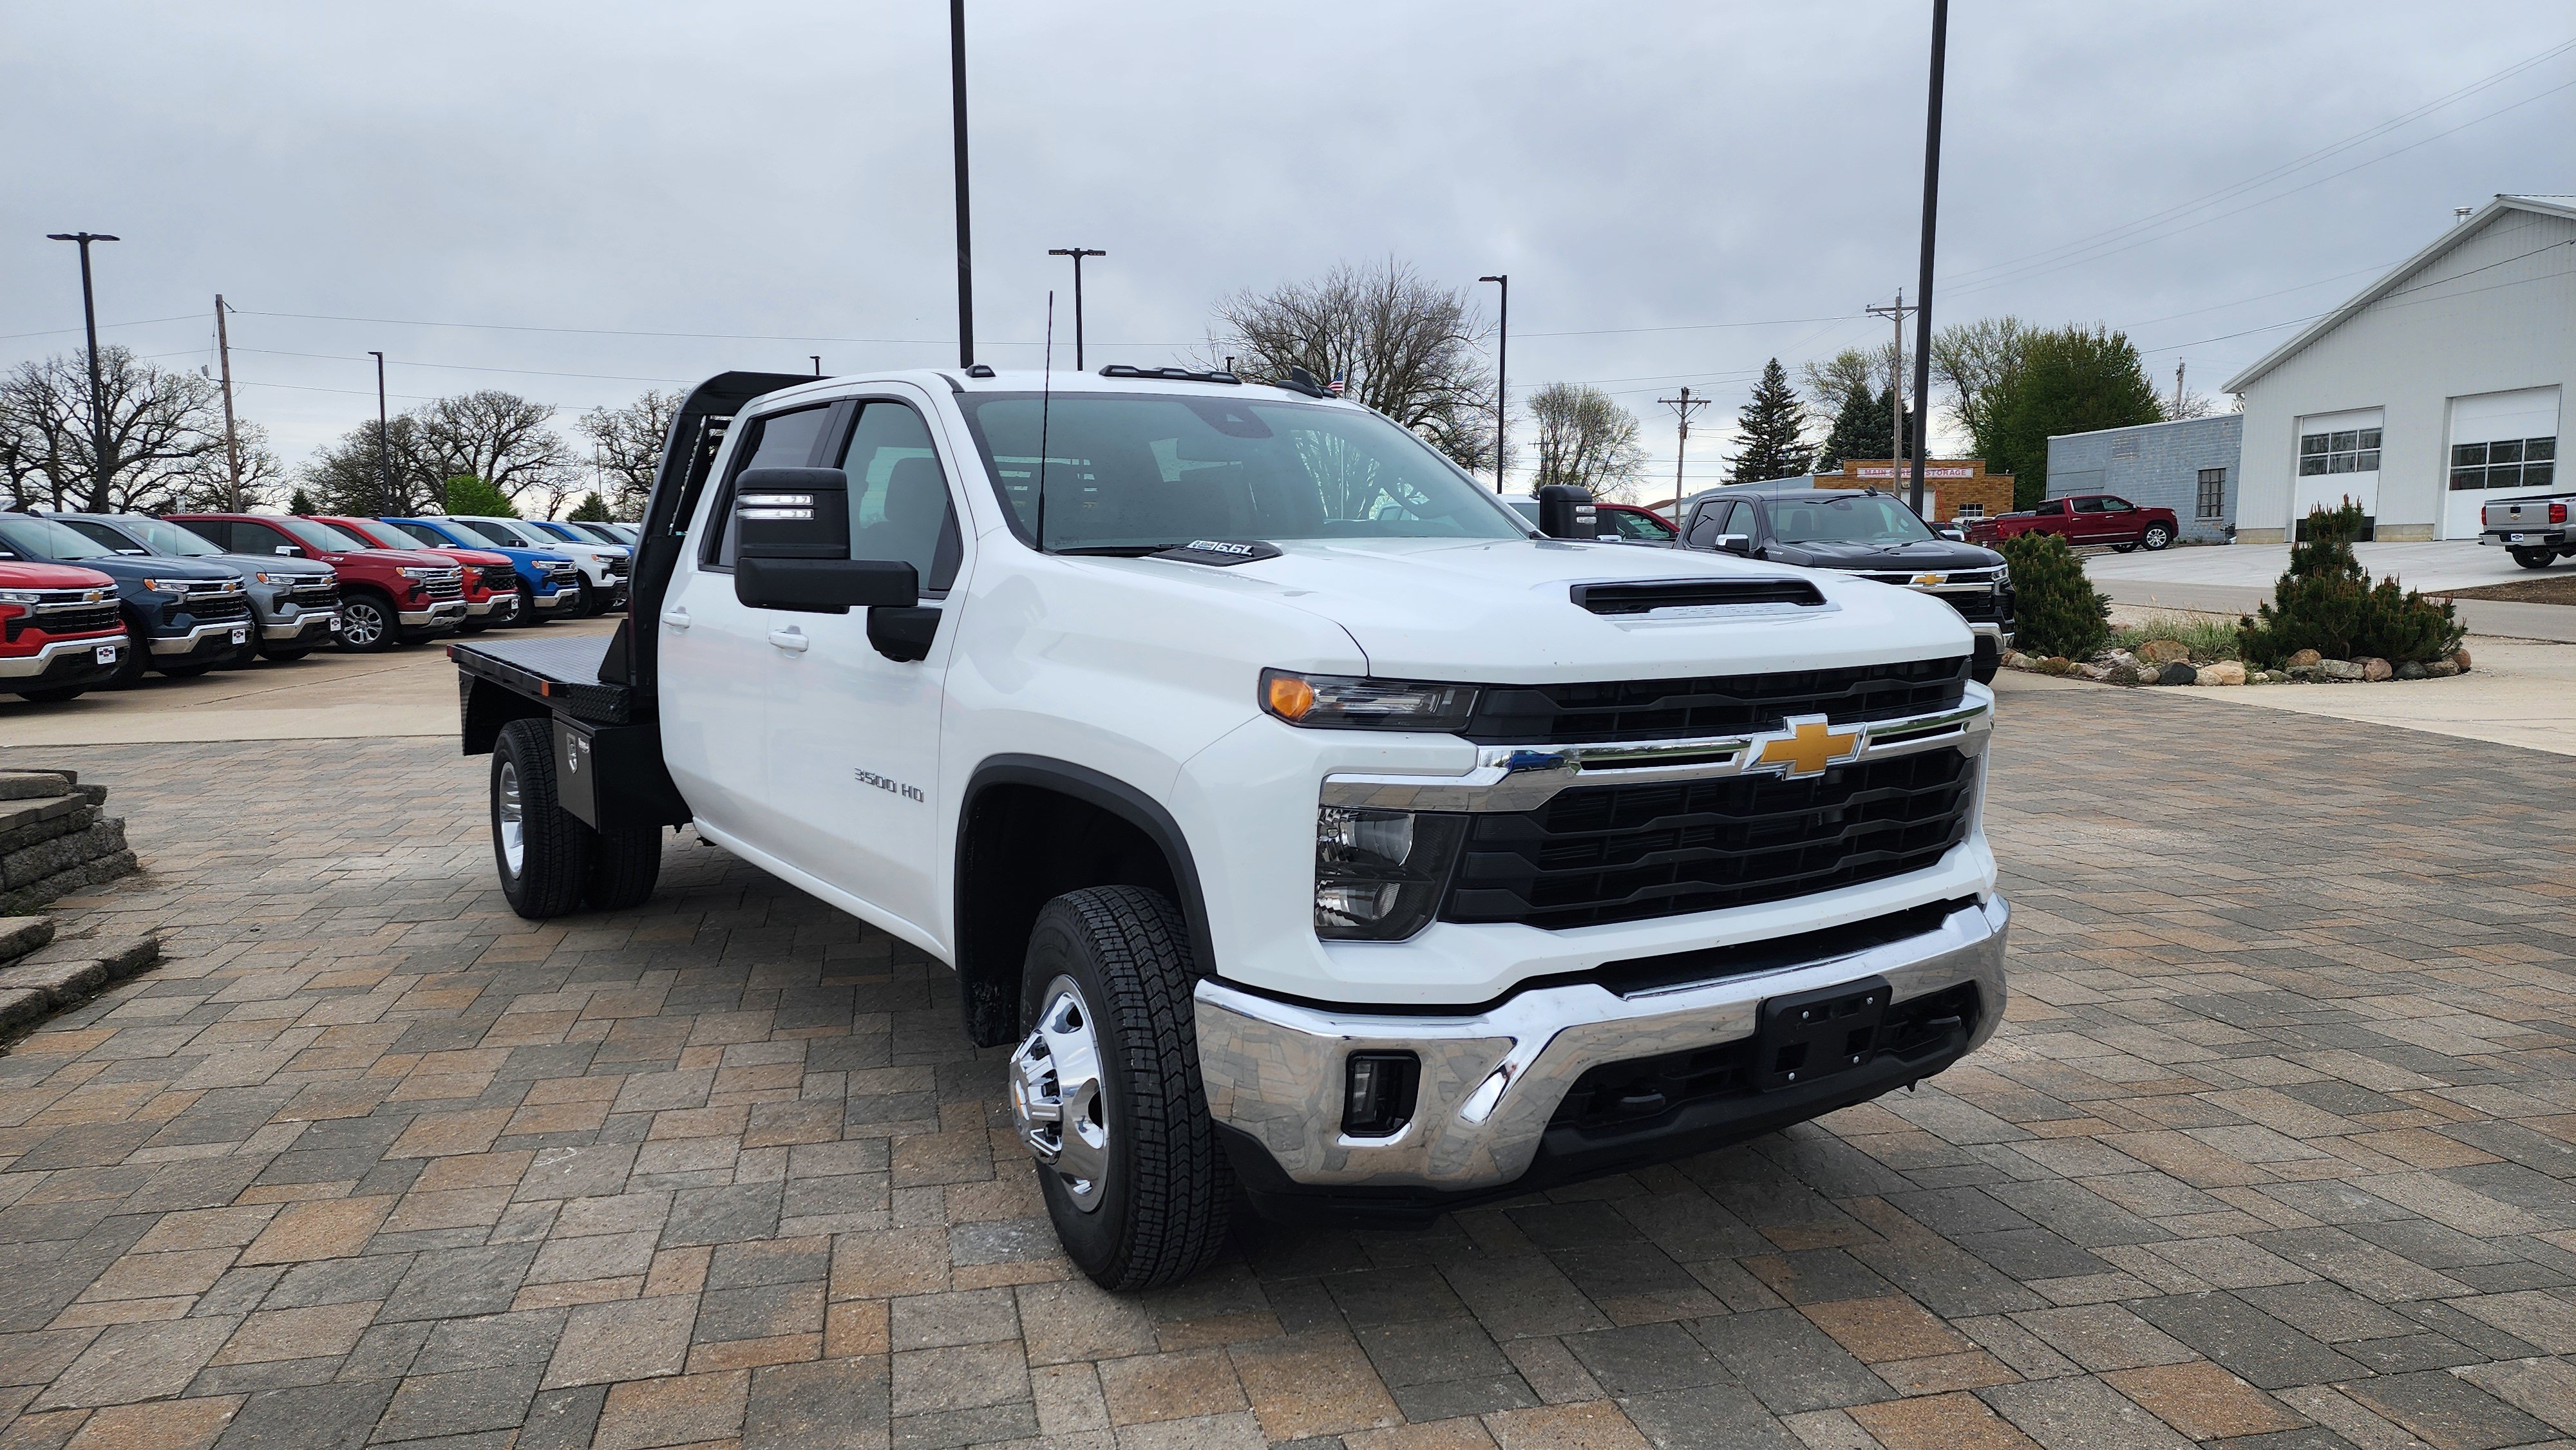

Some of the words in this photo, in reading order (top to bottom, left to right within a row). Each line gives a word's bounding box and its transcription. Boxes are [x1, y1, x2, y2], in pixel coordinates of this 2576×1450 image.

[1215, 543, 1252, 556] 6.6L
[855, 767, 896, 793] 3500
[902, 783, 924, 802] HD
